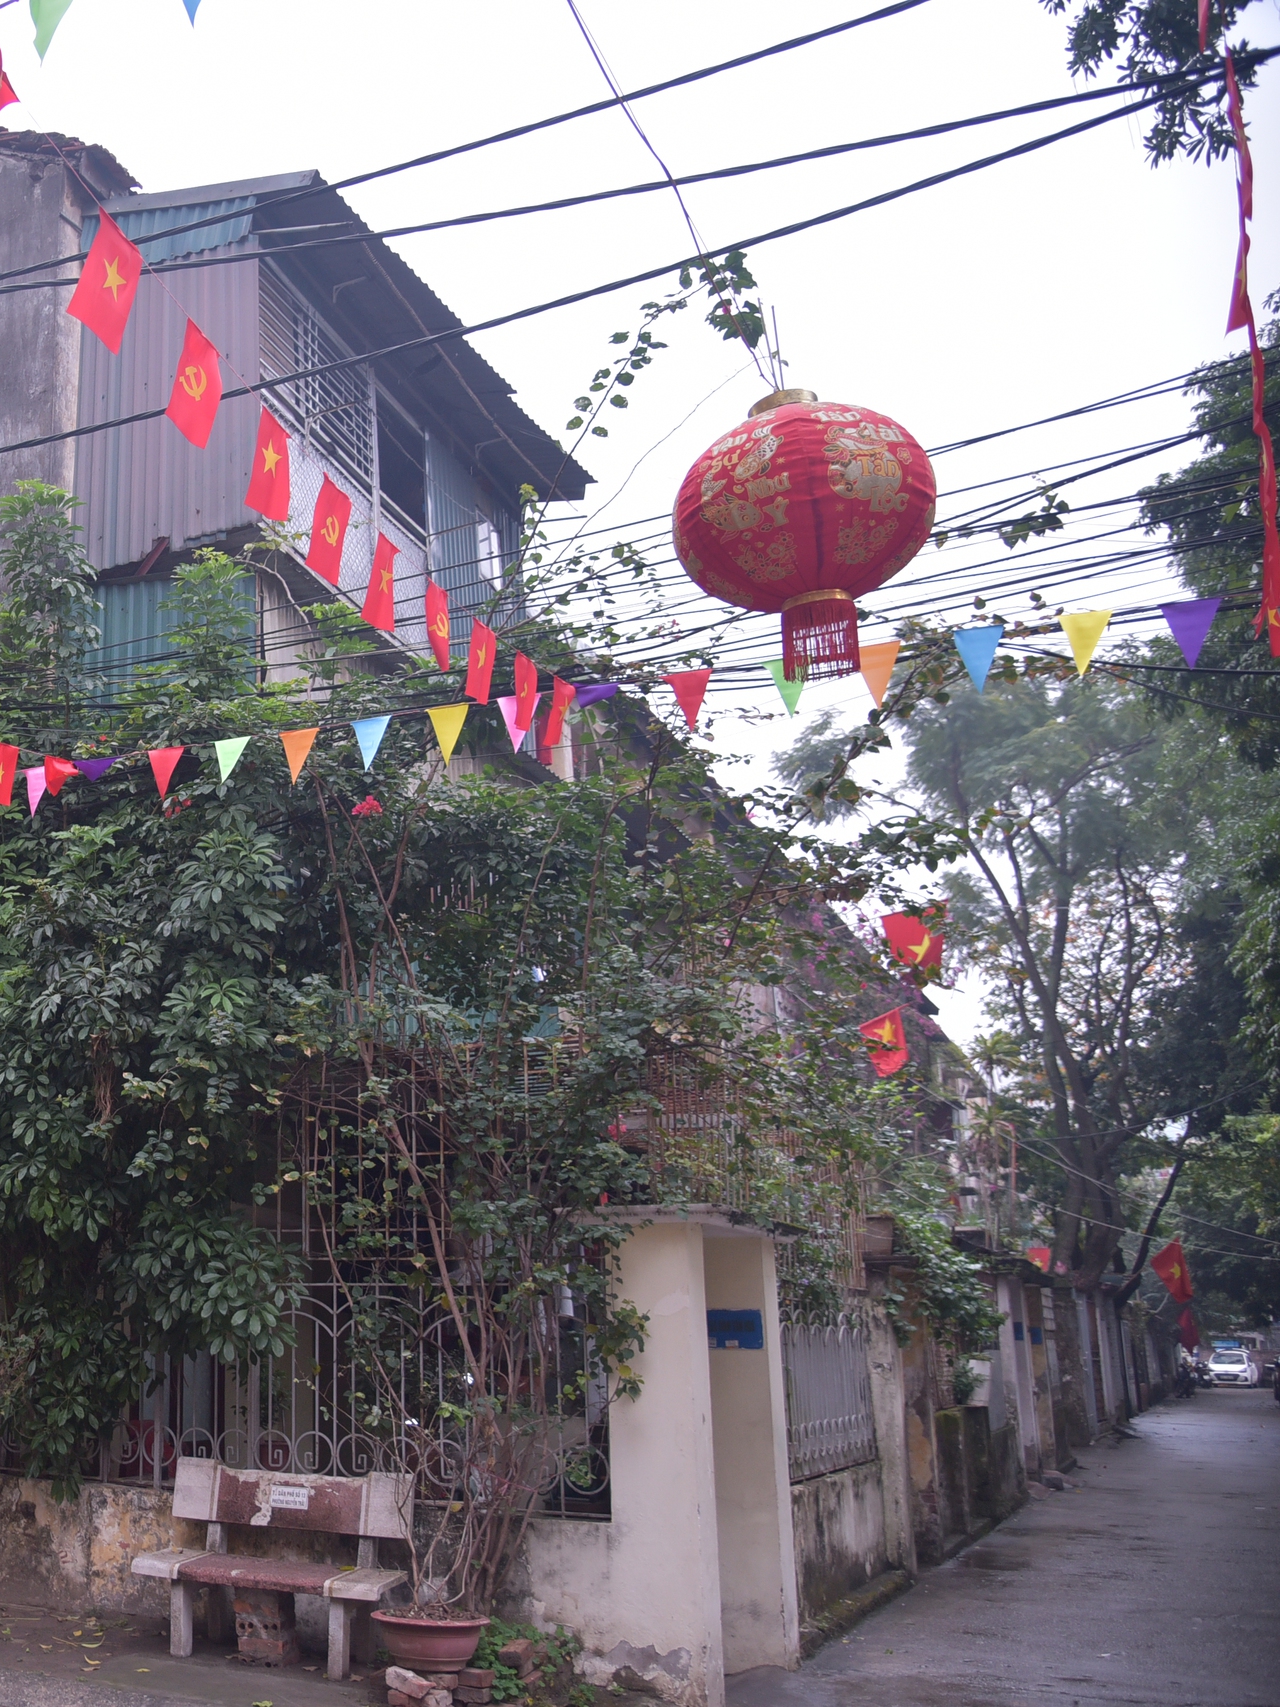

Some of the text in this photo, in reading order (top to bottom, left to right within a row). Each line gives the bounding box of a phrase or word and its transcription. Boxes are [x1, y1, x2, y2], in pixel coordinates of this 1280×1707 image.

[857, 451, 899, 478] Tấn
[744, 471, 791, 502] Như
[763, 496, 789, 527] Ý
